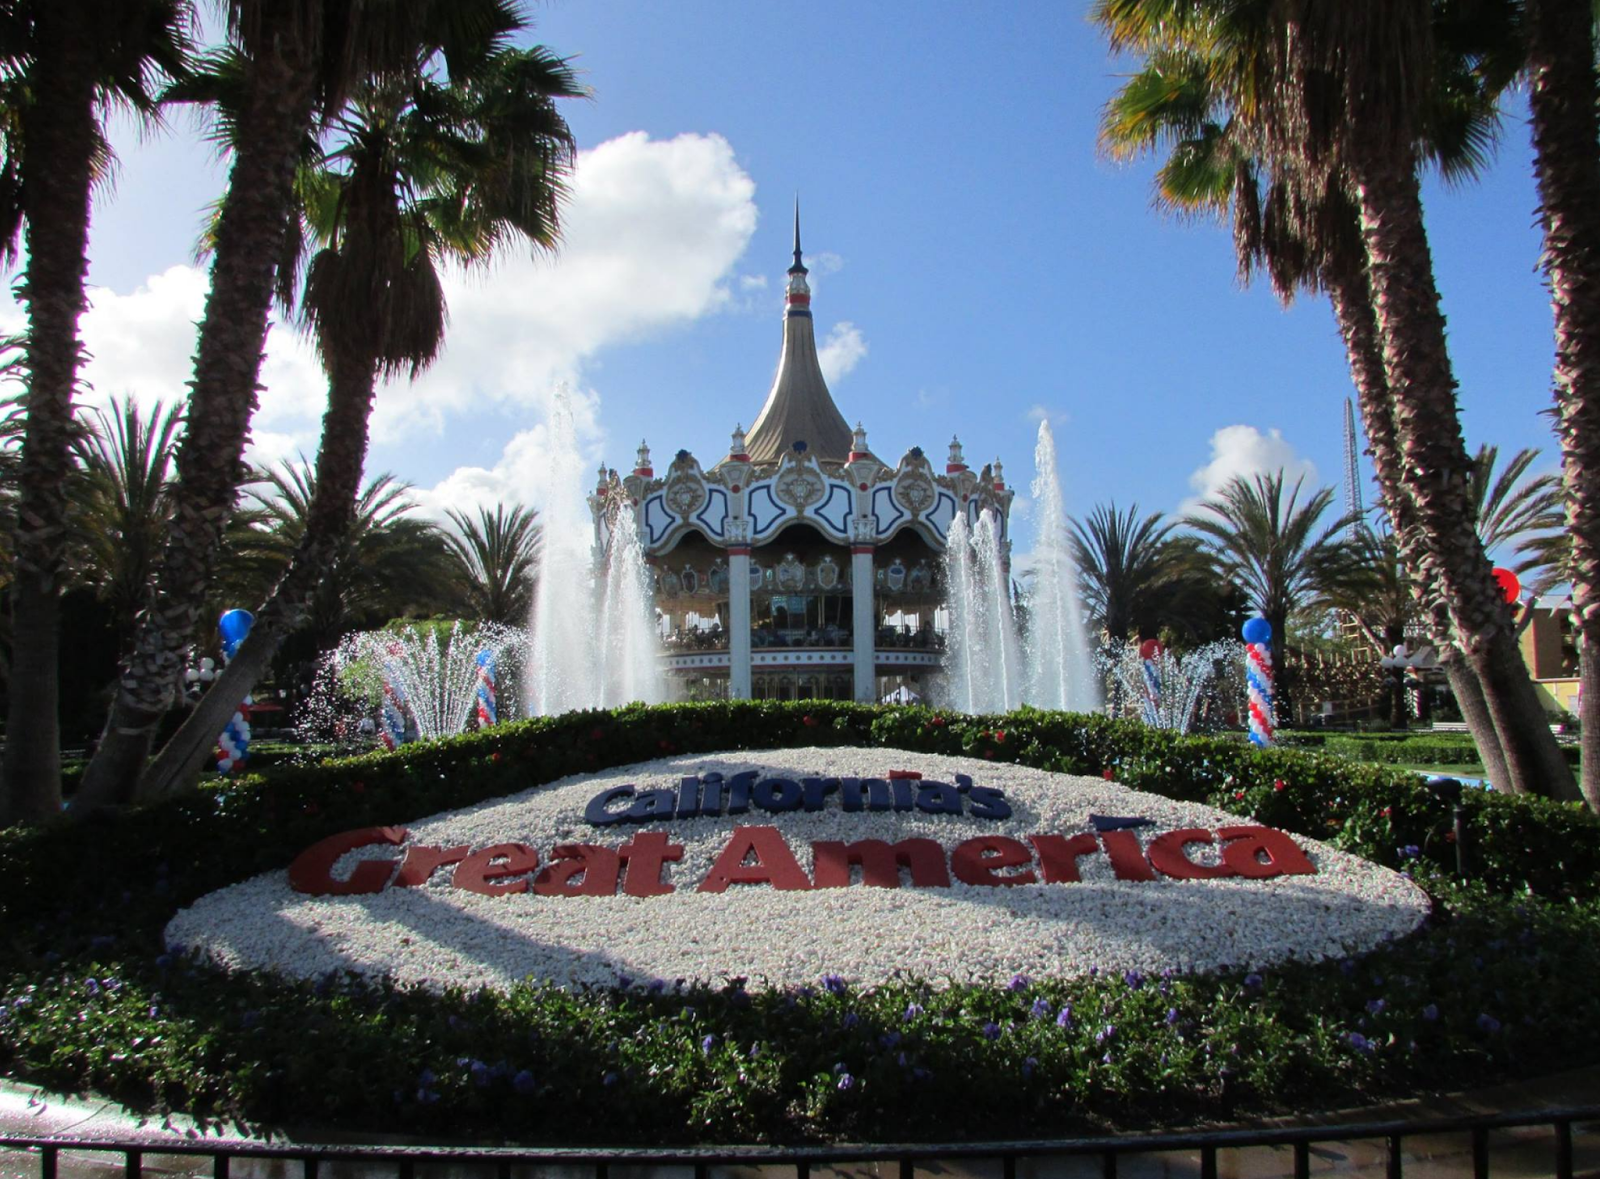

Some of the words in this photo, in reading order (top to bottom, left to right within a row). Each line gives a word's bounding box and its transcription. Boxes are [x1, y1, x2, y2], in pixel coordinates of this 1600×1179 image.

[585, 770, 1012, 824] California's
[289, 825, 684, 897] Great
[702, 814, 1317, 893] America
